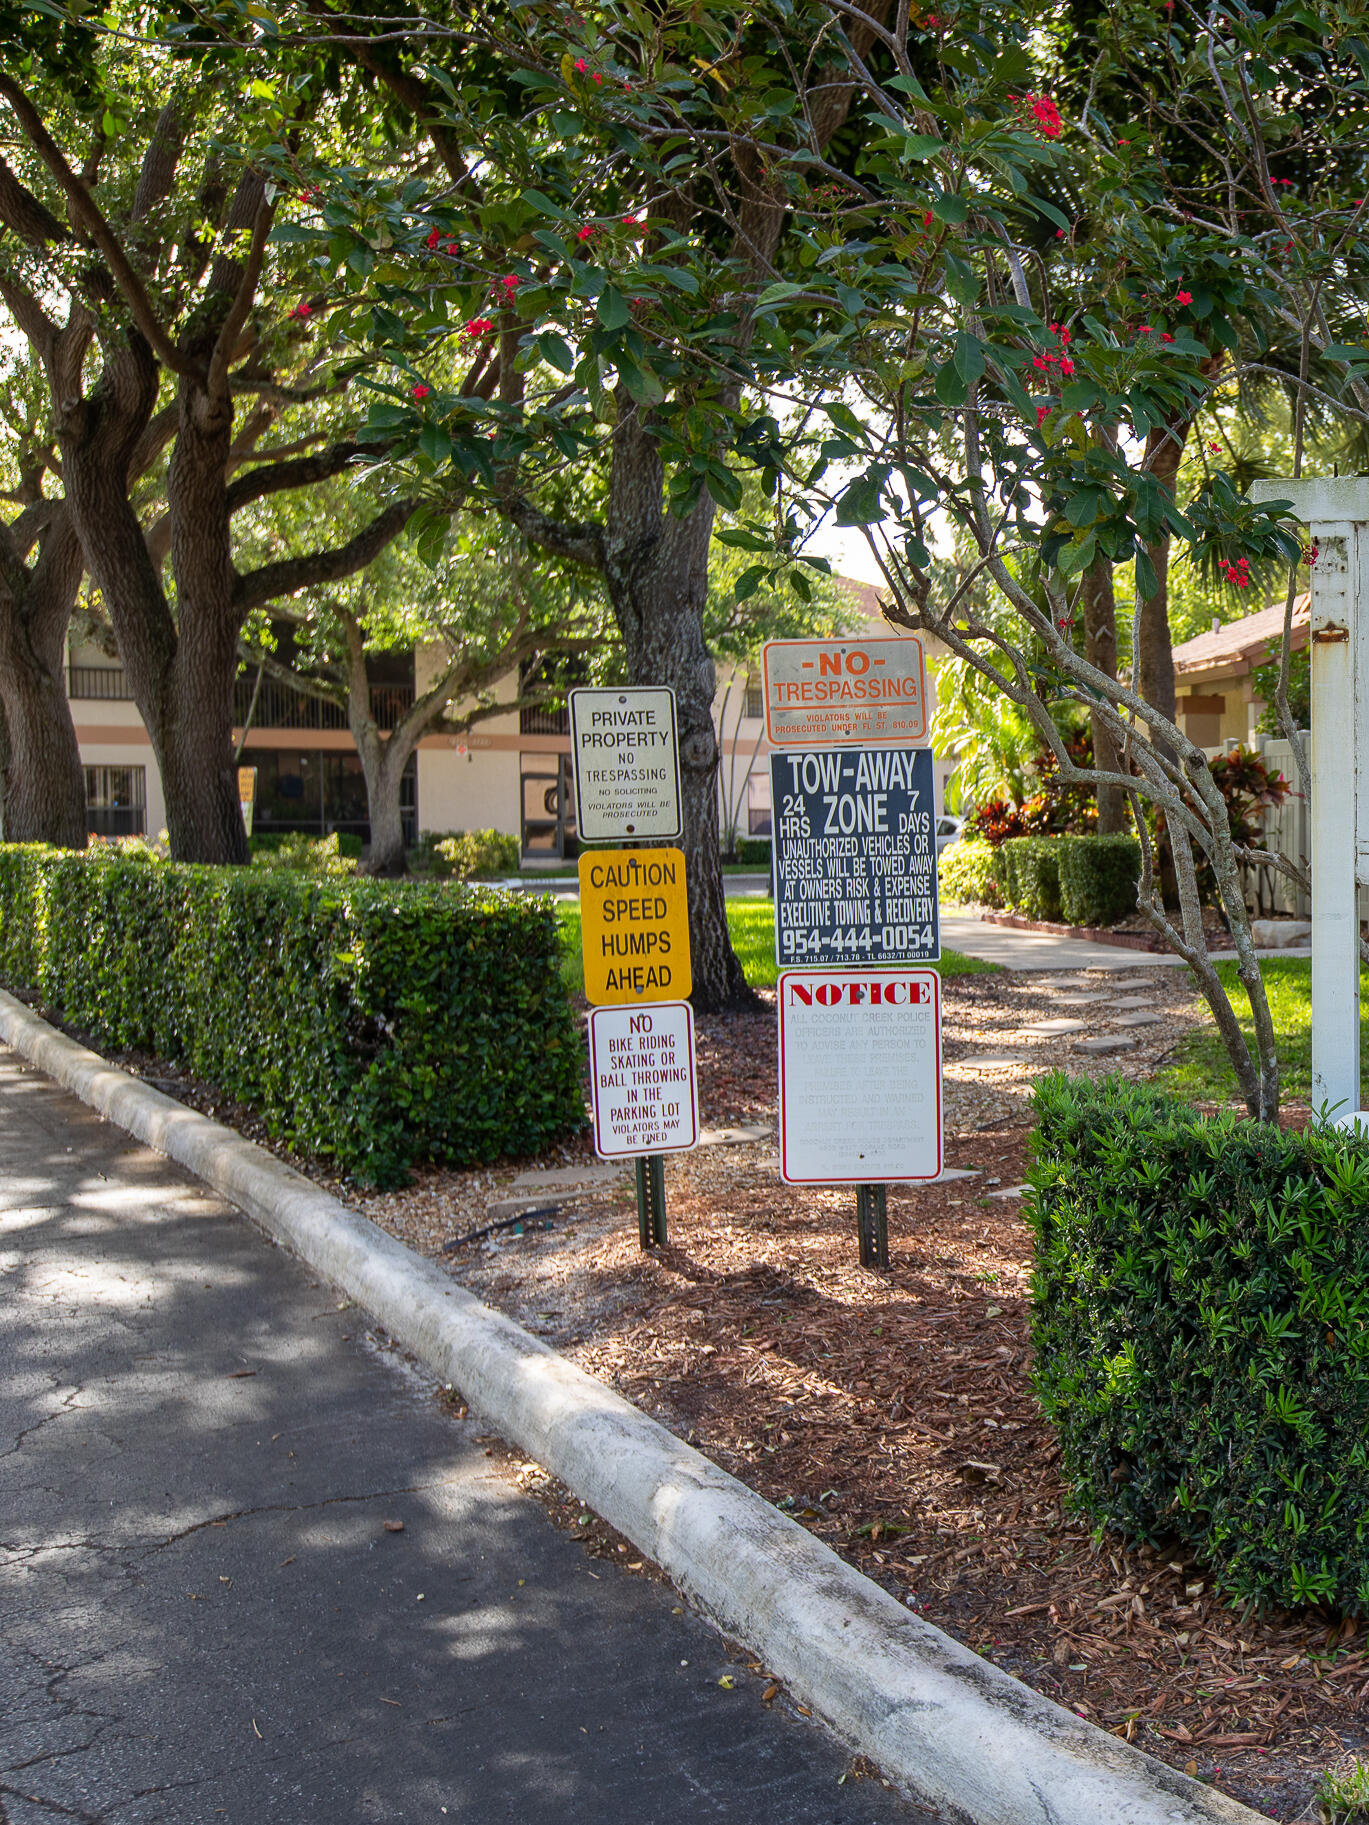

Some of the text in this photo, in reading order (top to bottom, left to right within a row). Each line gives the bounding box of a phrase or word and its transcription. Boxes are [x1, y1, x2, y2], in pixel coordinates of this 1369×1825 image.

[773, 677, 917, 702] TRESPASSING
[592, 710, 656, 727] PRIVATE
[806, 711, 888, 723] VIOLATORS WILL BE
[775, 723, 827, 734] PROSECUTED
[831, 721, 858, 732] UNDER
[862, 721, 871, 730] FL
[582, 731, 669, 748] PROPERTY
[618, 752, 635, 765] NO
[586, 768, 667, 782] TRESPASSING
[787, 752, 917, 795] TOW-AWAY
[599, 787, 657, 796] NO SOLICITING
[907, 790, 920, 812] 7
[588, 800, 671, 811] VIOLATORS WILL BE
[603, 810, 658, 819] PROSECUTED
[782, 795, 806, 816] 24
[823, 793, 889, 835] ZONE
[779, 816, 811, 838] HRS
[899, 812, 930, 834] DAYS
[782, 834, 929, 860] UNAUTHORIZED VEHICLES OR
[590, 863, 676, 889] CAUTION
[778, 855, 934, 880] VESSELS WILL BE TOWED AWAY
[784, 876, 930, 900] AT OWNERS RISK & EXPENSE
[602, 897, 667, 922] SPEED
[781, 897, 934, 928] EXECUTIVE TOWING & RECOVERY
[602, 931, 671, 956] HUMPS
[782, 924, 935, 955] 954-444-0054
[606, 965, 672, 991] AHEAD
[788, 982, 931, 1007] NOTICE
[630, 1015, 653, 1034] NO
[791, 1011, 931, 1024] ALL COCONUT CREEK POLICE
[868, 1026, 927, 1036] AUTHORIZED
[609, 1034, 675, 1053] BIKE RIDING
[872, 1040, 910, 1049] PERSON
[913, 1039, 926, 1049] TO
[611, 1051, 675, 1070] SKATING OR
[600, 1068, 687, 1088] BALL THROWING
[627, 1087, 662, 1103] IN THE
[611, 1103, 680, 1122] PARKING LOT
[612, 1120, 680, 1135] VIOLATORS MAY
[626, 1132, 668, 1145] BE FINED
